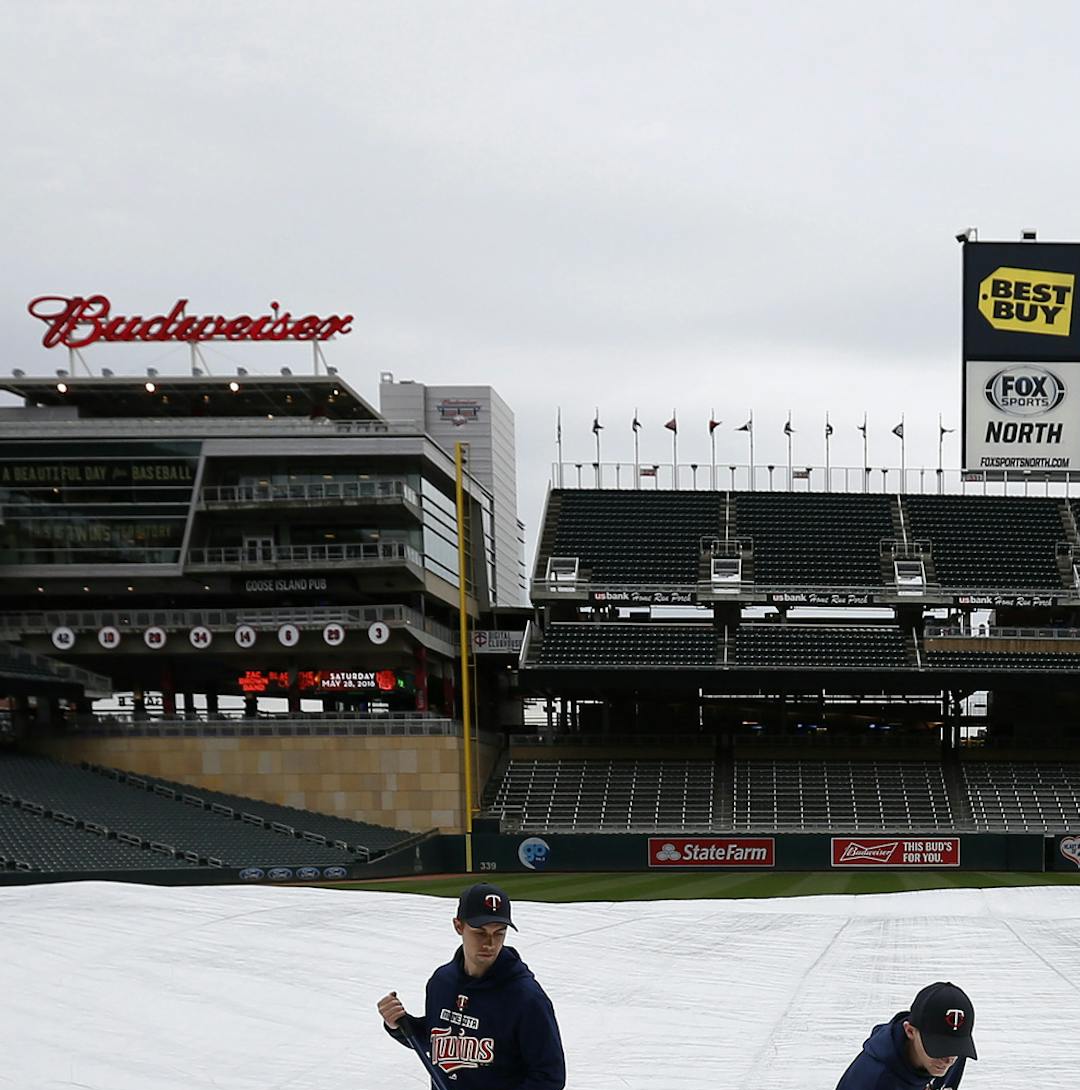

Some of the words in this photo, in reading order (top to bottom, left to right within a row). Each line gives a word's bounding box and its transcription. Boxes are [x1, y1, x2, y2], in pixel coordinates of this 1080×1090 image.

[991, 279, 1071, 304] BEST
[993, 300, 1062, 324] BUY
[28, 294, 353, 348] Budweiser
[1002, 376, 1047, 397] FOX
[1001, 398, 1049, 406] SPORTS
[985, 421, 1063, 443] NORTH
[980, 457, 1069, 467] FOXSPORTSNORTH.COM
[85, 465, 107, 480] DAY
[131, 465, 193, 480] BASEBALL
[245, 580, 274, 591] GOOSE
[275, 579, 307, 591] ISLAND
[308, 578, 327, 590] PUB
[56, 631, 70, 643] 42
[193, 631, 207, 643] 34
[239, 630, 251, 642] 14
[375, 627, 382, 638] 3
[329, 672, 375, 681] SATURDAY
[321, 680, 341, 688] MAY
[845, 846, 891, 858] Budweiser
[902, 842, 923, 852] THIS
[925, 841, 953, 852] BUD'S
[903, 852, 922, 862] FOR
[923, 852, 943, 862] YOU.
[480, 861, 497, 871] 339
[431, 1026, 495, 1070] Twins
